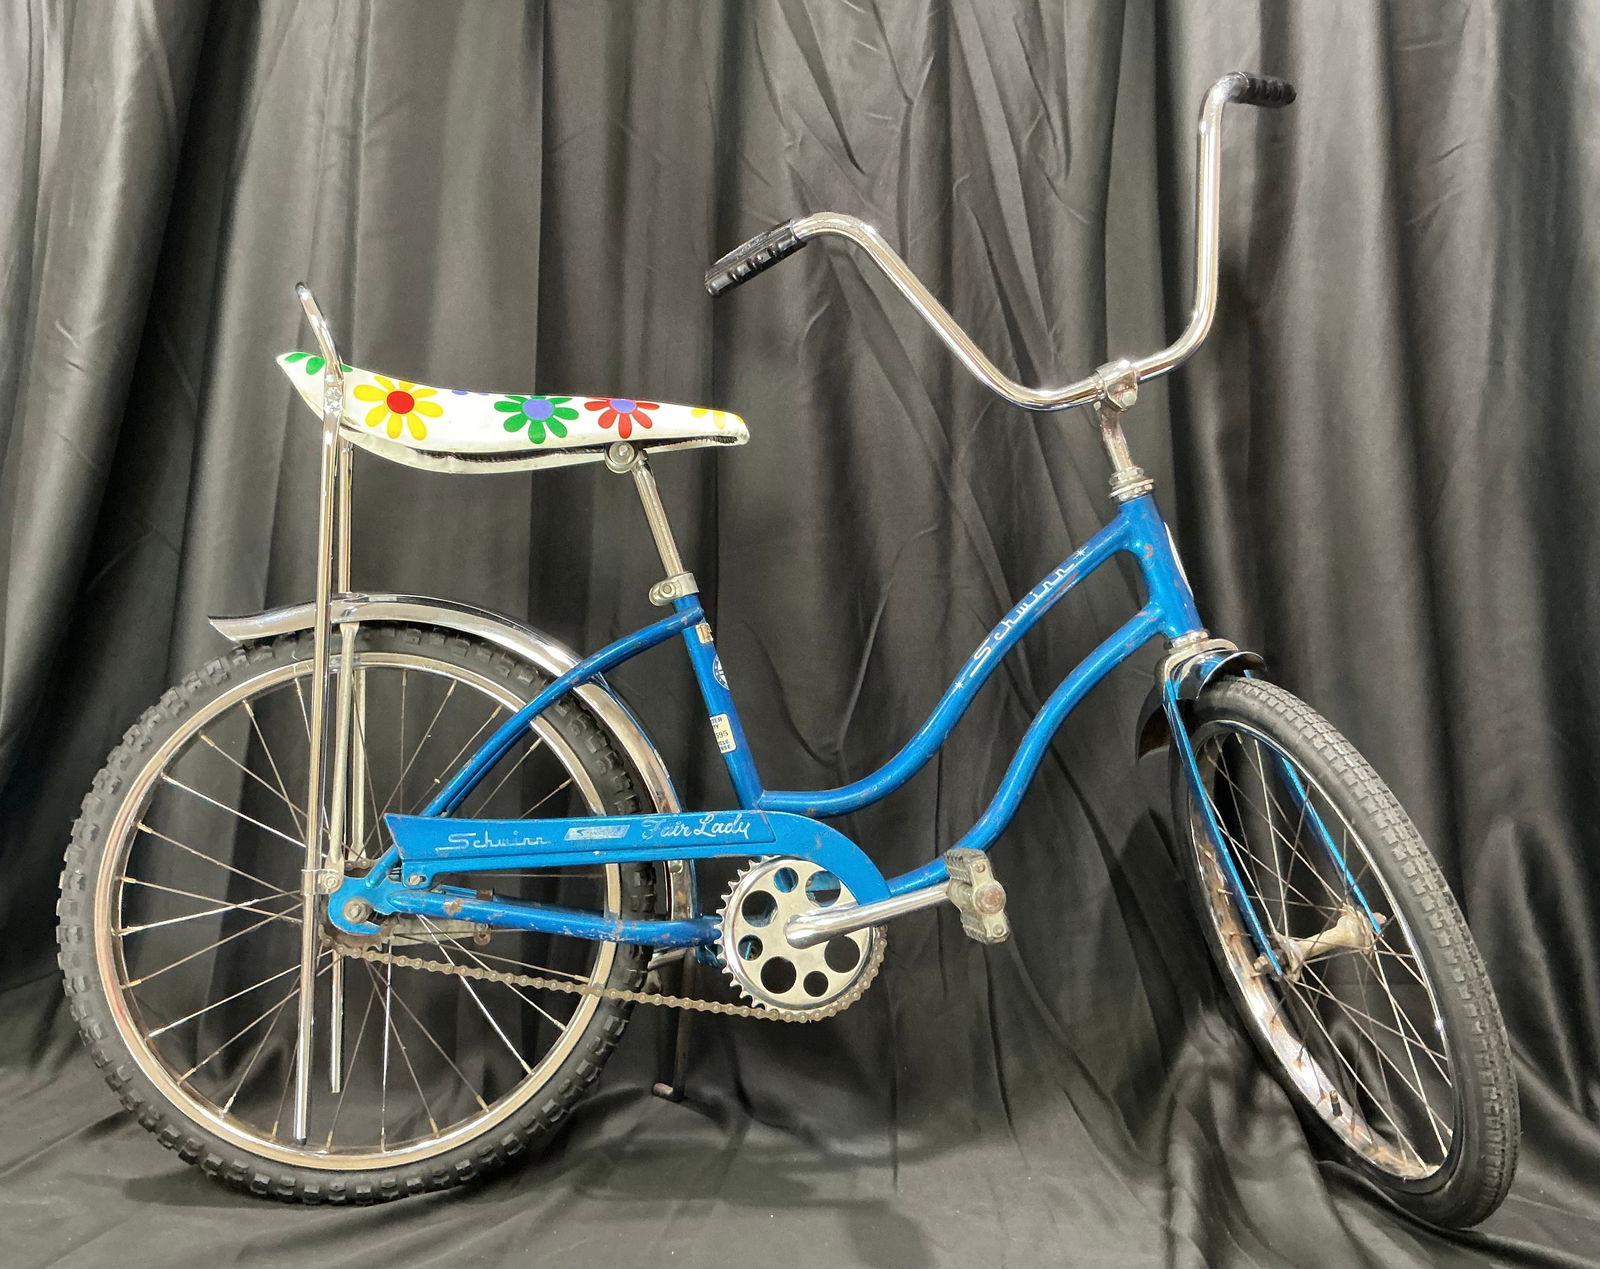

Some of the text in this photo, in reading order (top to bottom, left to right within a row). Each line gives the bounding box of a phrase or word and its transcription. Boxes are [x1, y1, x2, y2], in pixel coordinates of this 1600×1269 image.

[969, 563, 1075, 678] Schwinn
[641, 818, 692, 840] Fair
[693, 813, 751, 840] Lady
[434, 830, 551, 853] Schwinn
